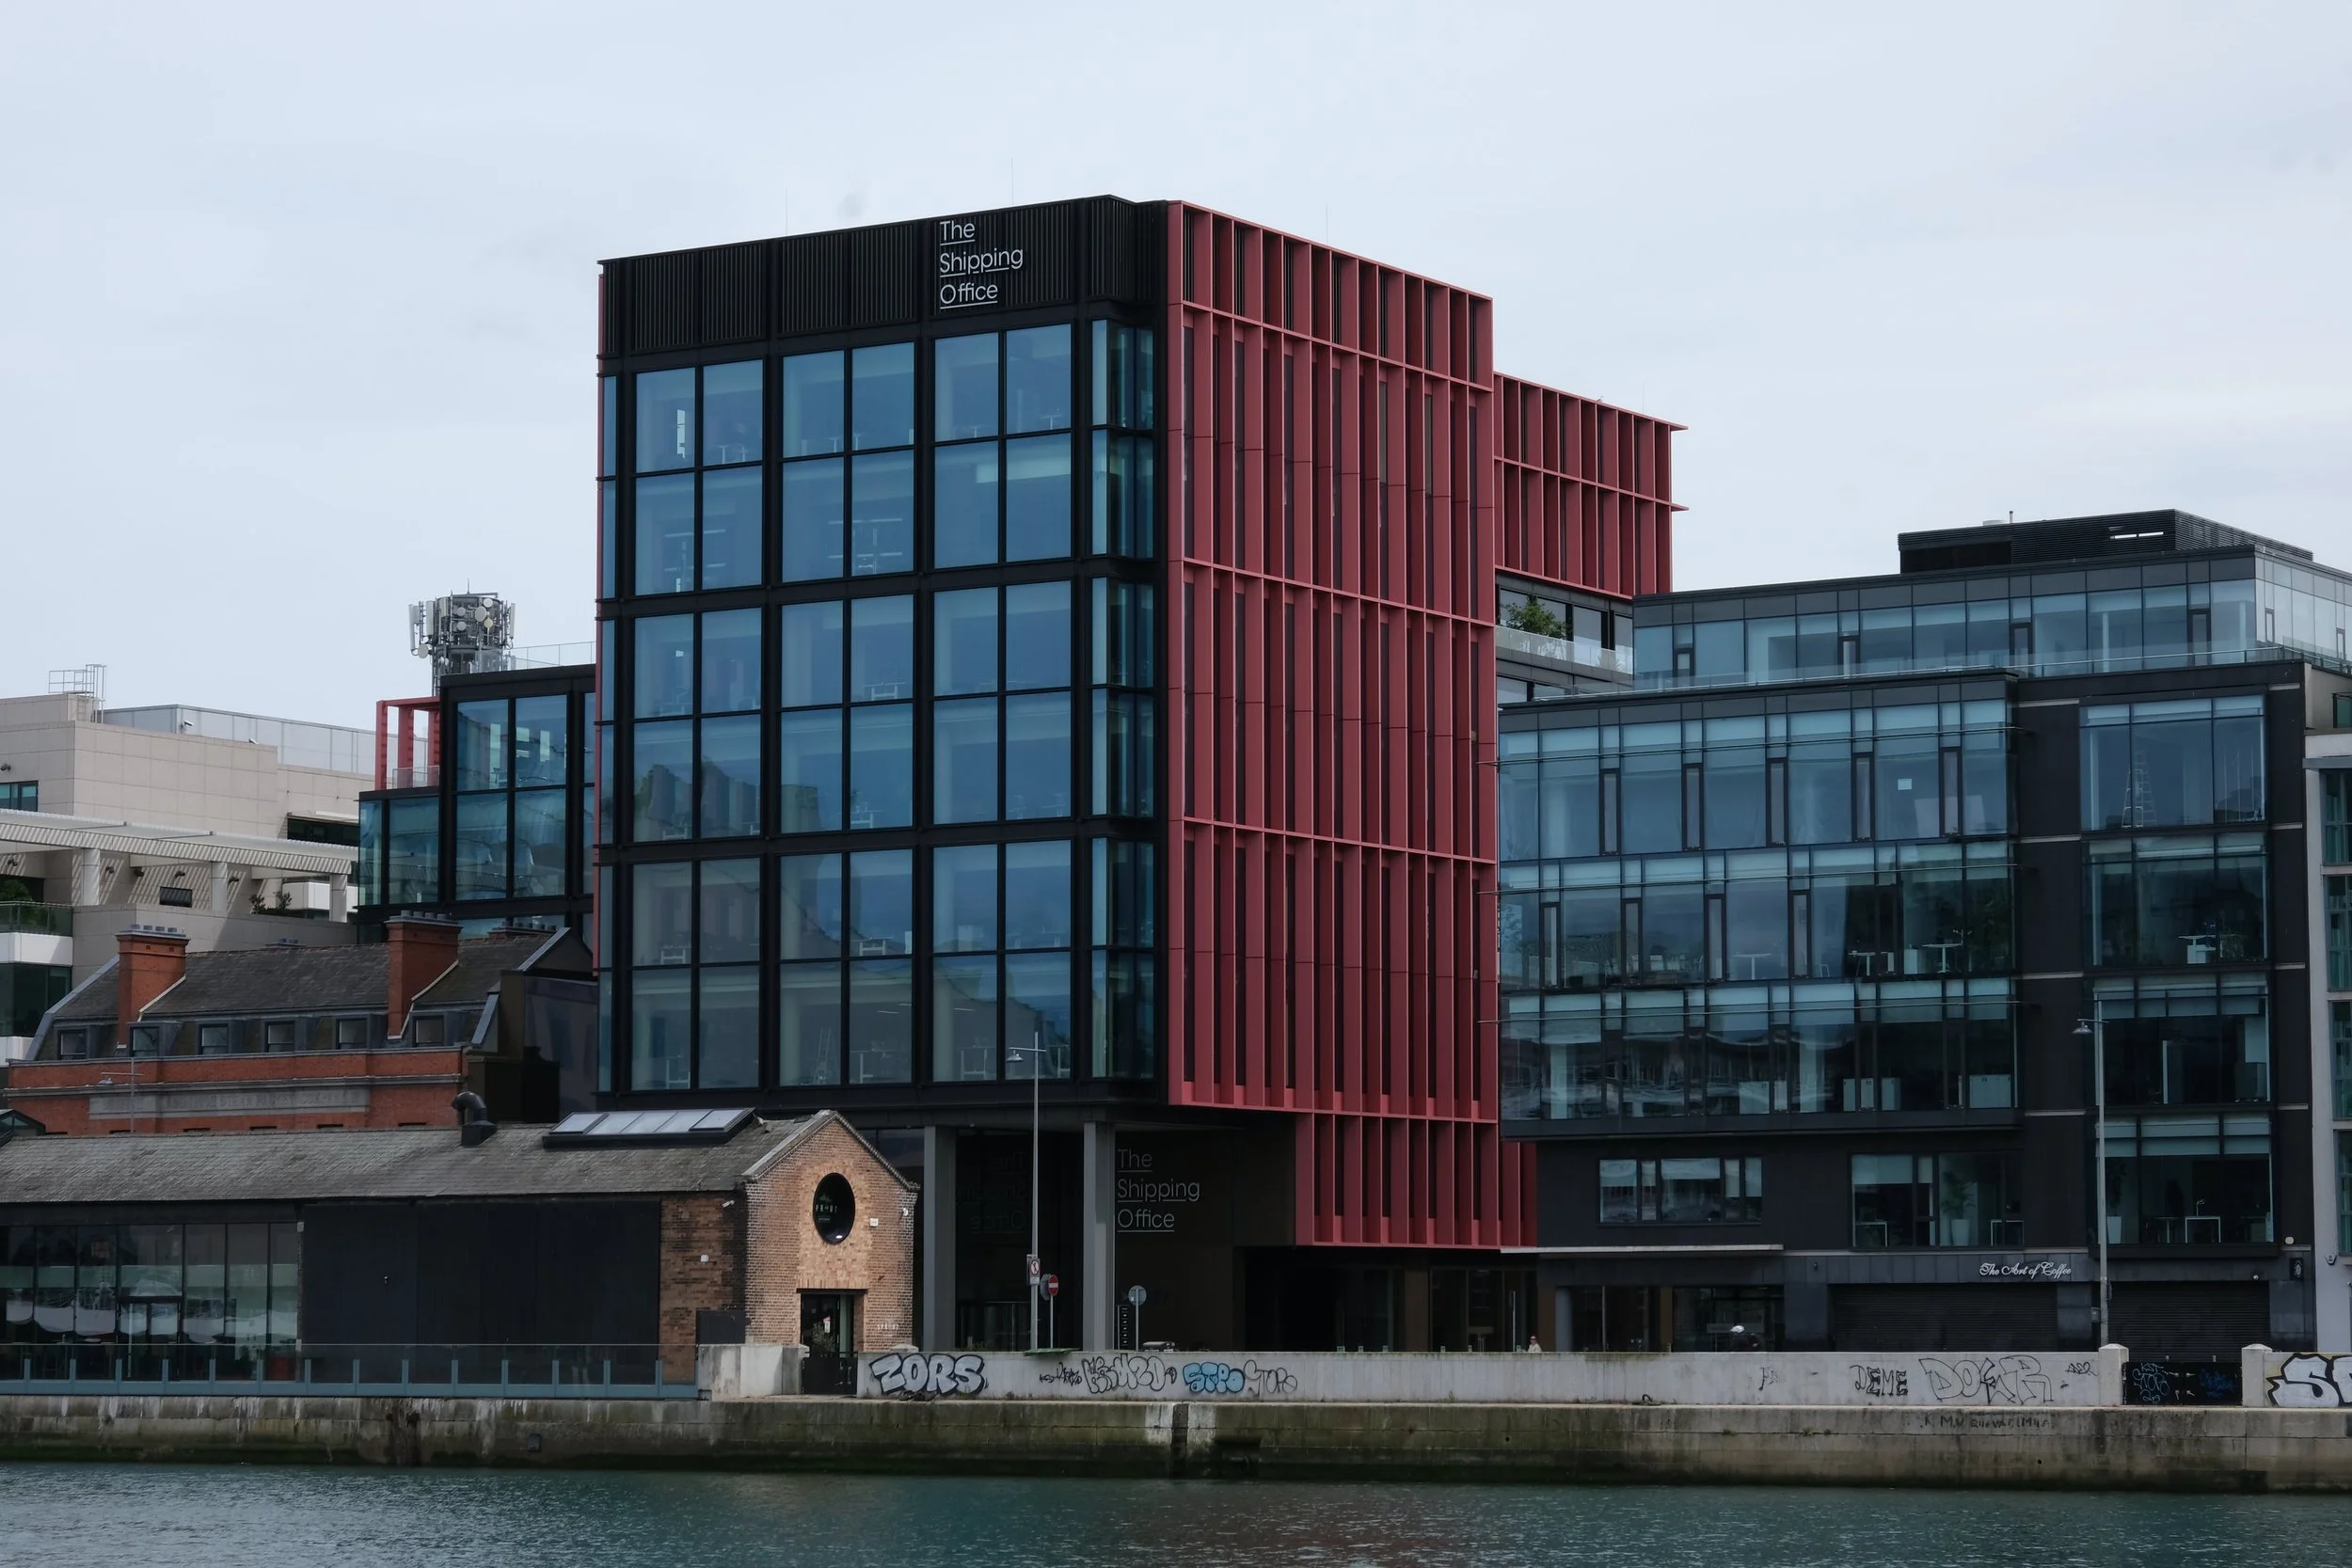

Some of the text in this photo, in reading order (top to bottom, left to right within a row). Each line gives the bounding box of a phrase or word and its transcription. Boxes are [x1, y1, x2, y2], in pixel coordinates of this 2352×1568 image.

[940, 220, 976, 241] The
[940, 247, 1024, 275] Shipping
[941, 282, 998, 304] Office
[1118, 1147, 1152, 1168] The
[1118, 1178, 1200, 1202] Shipping
[1118, 1209, 1175, 1228] Office
[1979, 1261, 2072, 1279] The Art of Coffee
[869, 1352, 985, 1398] ZORS
